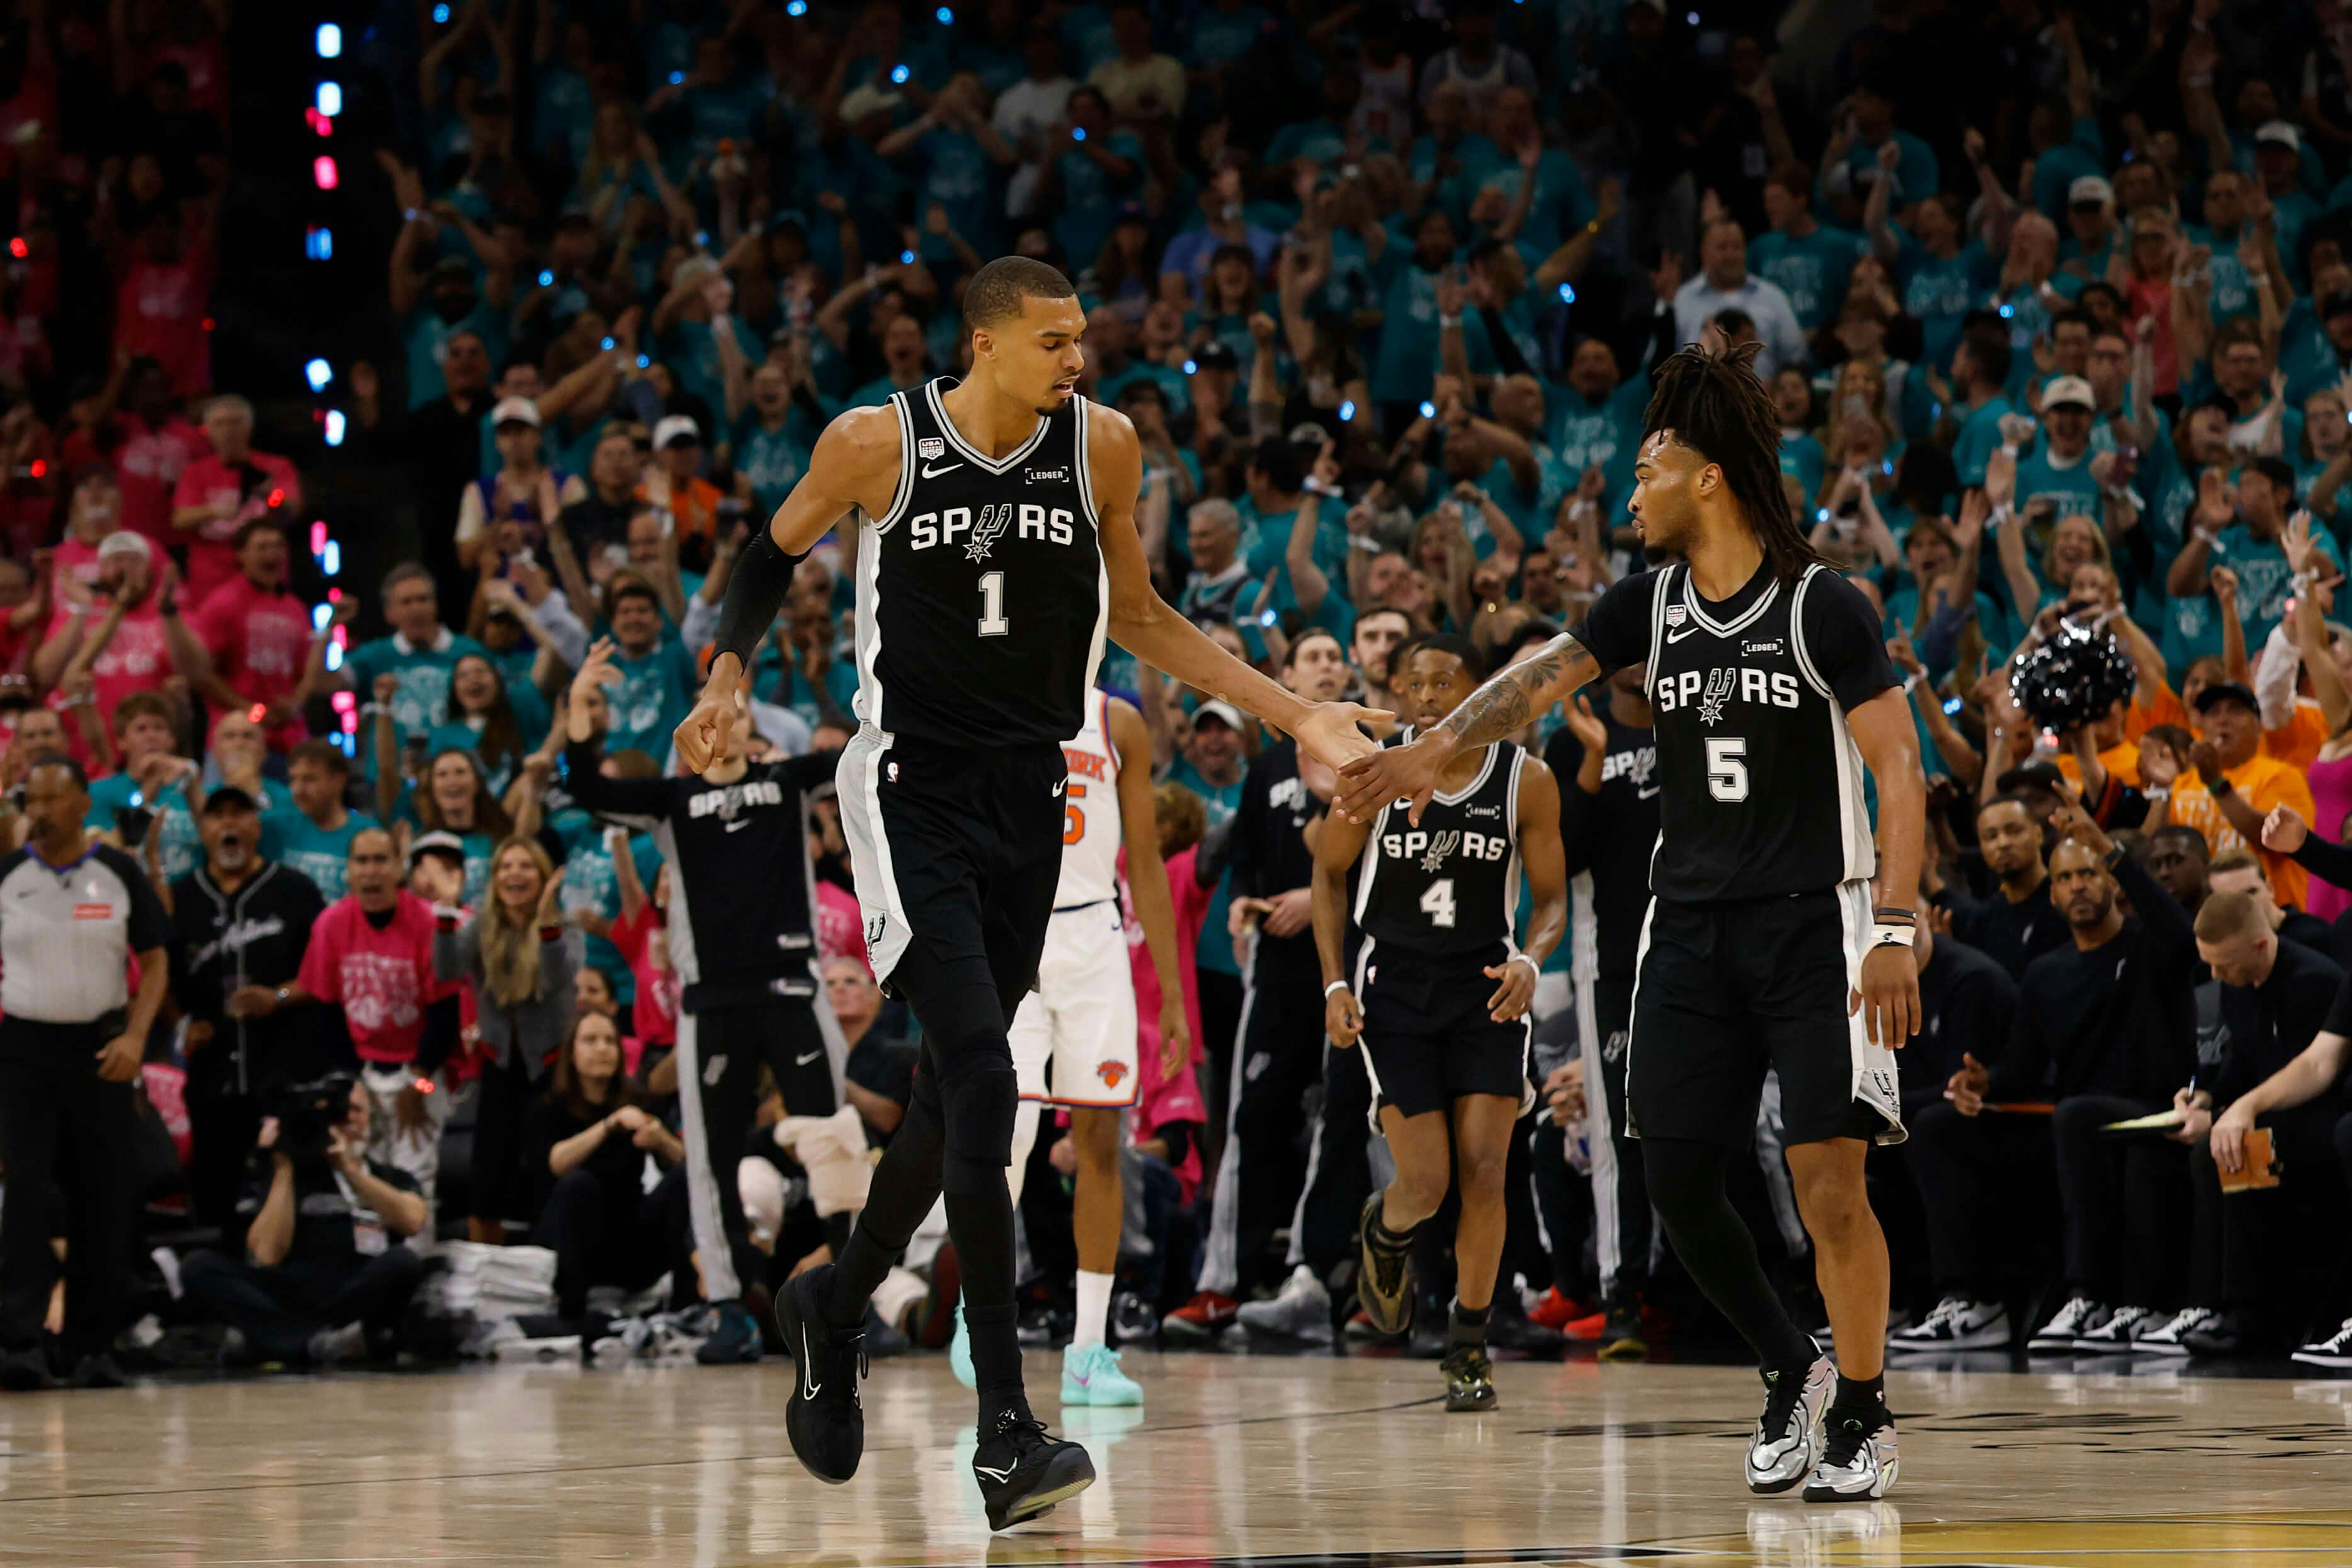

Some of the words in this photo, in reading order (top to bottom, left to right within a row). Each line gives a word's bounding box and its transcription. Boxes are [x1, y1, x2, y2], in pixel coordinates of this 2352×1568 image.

[1031, 470, 1064, 480] LEDGER
[911, 503, 1074, 564] SPURS
[978, 571, 1008, 637] 1
[1746, 643, 1778, 652] LEDGER
[1658, 668, 1799, 727] SPURS
[1063, 748, 1106, 782] ORK
[1601, 746, 1657, 785] SPU
[1705, 737, 1749, 802] 5
[1383, 830, 1506, 873] SPURS
[1419, 878, 1457, 928] 4
